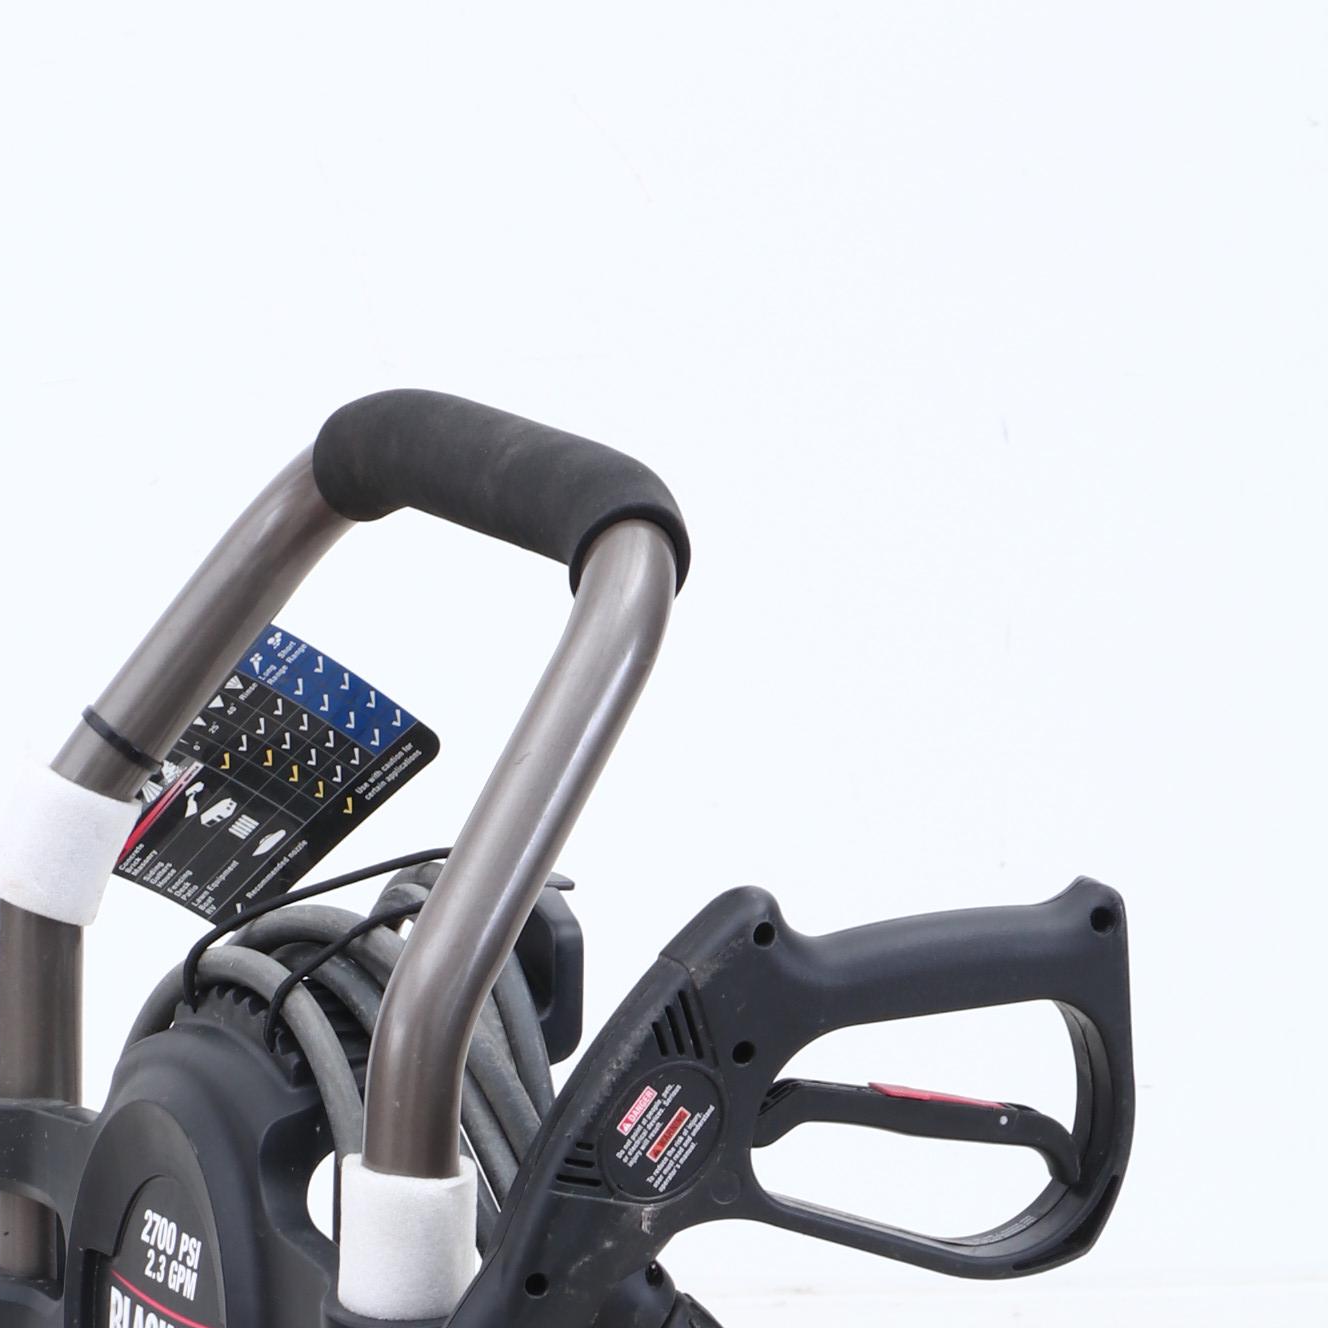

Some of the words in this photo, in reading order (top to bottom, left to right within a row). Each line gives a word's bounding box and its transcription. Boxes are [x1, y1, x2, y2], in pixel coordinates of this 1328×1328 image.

[277, 640, 296, 659] Short
[285, 643, 307, 664] Range
[257, 664, 277, 681] Long
[266, 664, 288, 685] Range
[238, 682, 258, 701] Rinse
[354, 781, 370, 794] Use
[367, 770, 383, 783] with
[380, 750, 404, 772] caution
[401, 742, 413, 752] for
[364, 780, 387, 800] certain
[384, 749, 422, 782] applications
[245, 856, 290, 899] Recommended
[287, 839, 308, 858] nozzle
[630, 1090, 654, 1122] DANGER
[140, 1208, 177, 1257] 2700
[178, 1232, 202, 1269] PSI
[144, 1251, 166, 1284] 2.3
[168, 1260, 199, 1301] GPM
